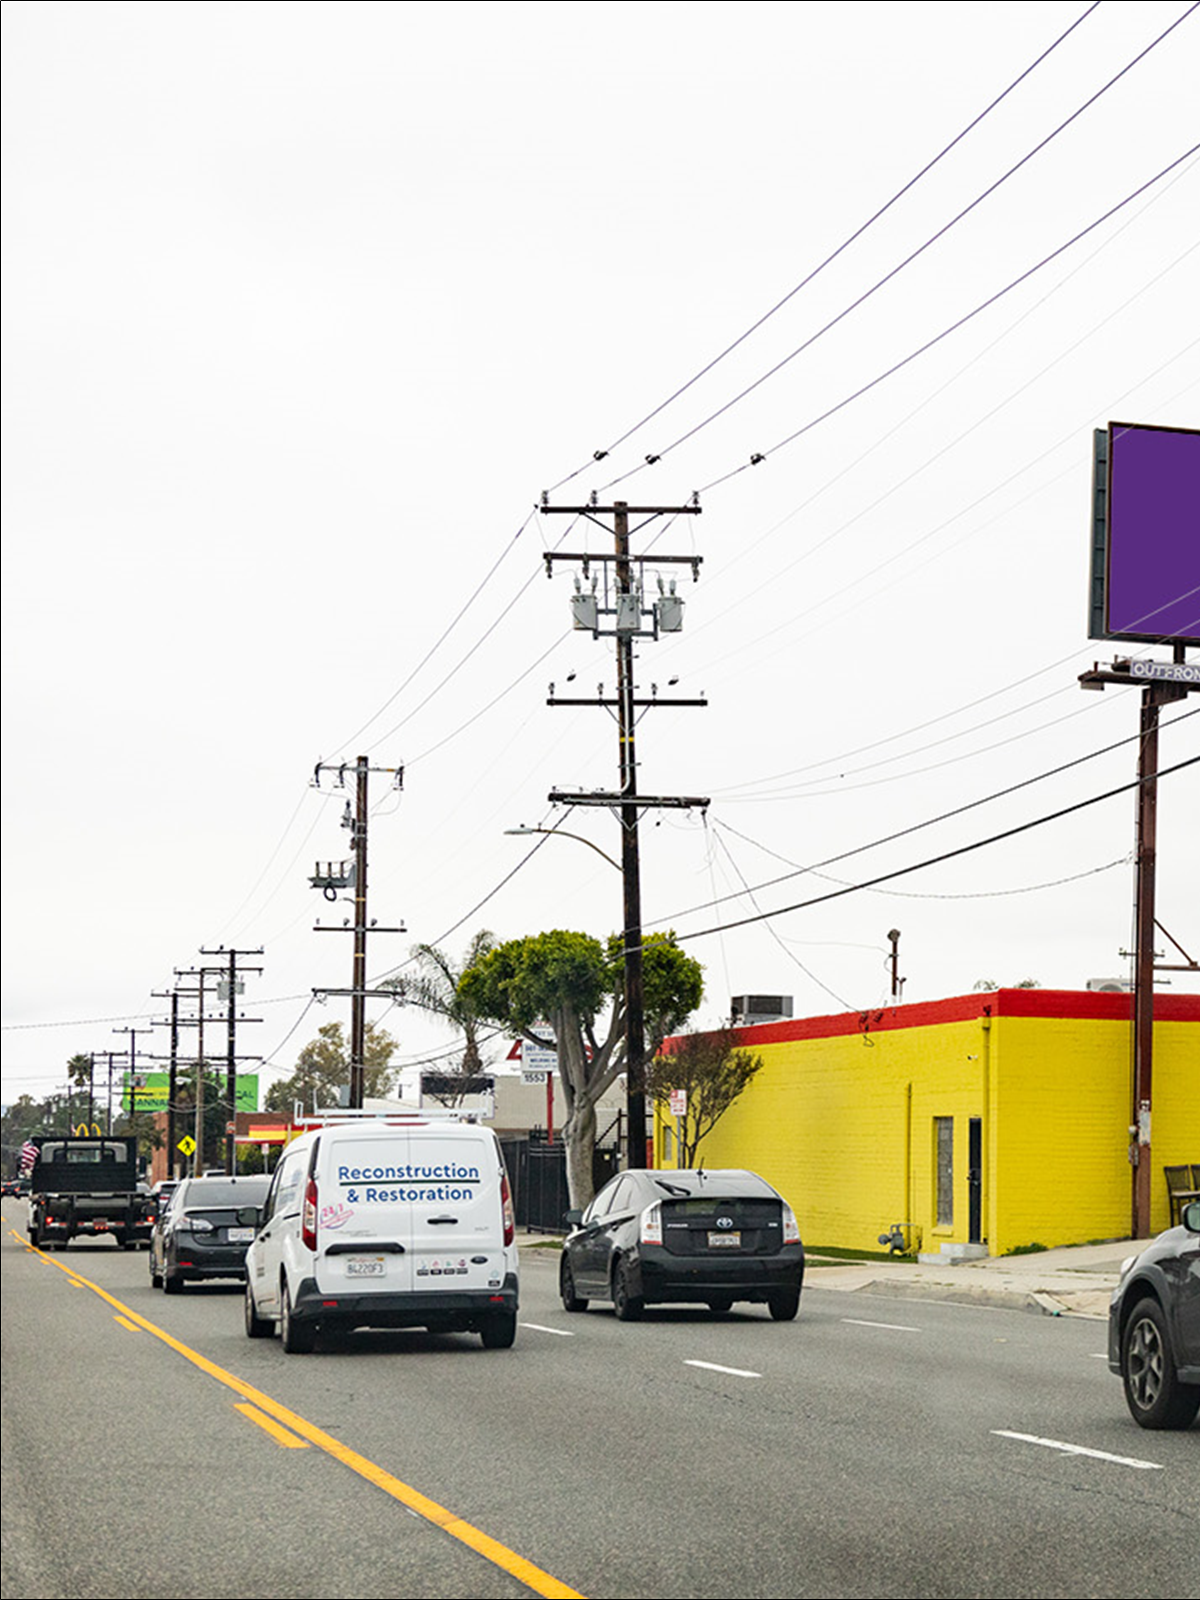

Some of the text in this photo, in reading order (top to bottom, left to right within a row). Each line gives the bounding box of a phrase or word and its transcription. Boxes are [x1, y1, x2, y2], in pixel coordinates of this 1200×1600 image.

[338, 1163, 480, 1180] Reconstruction
[347, 1185, 473, 1203] & Restoration
